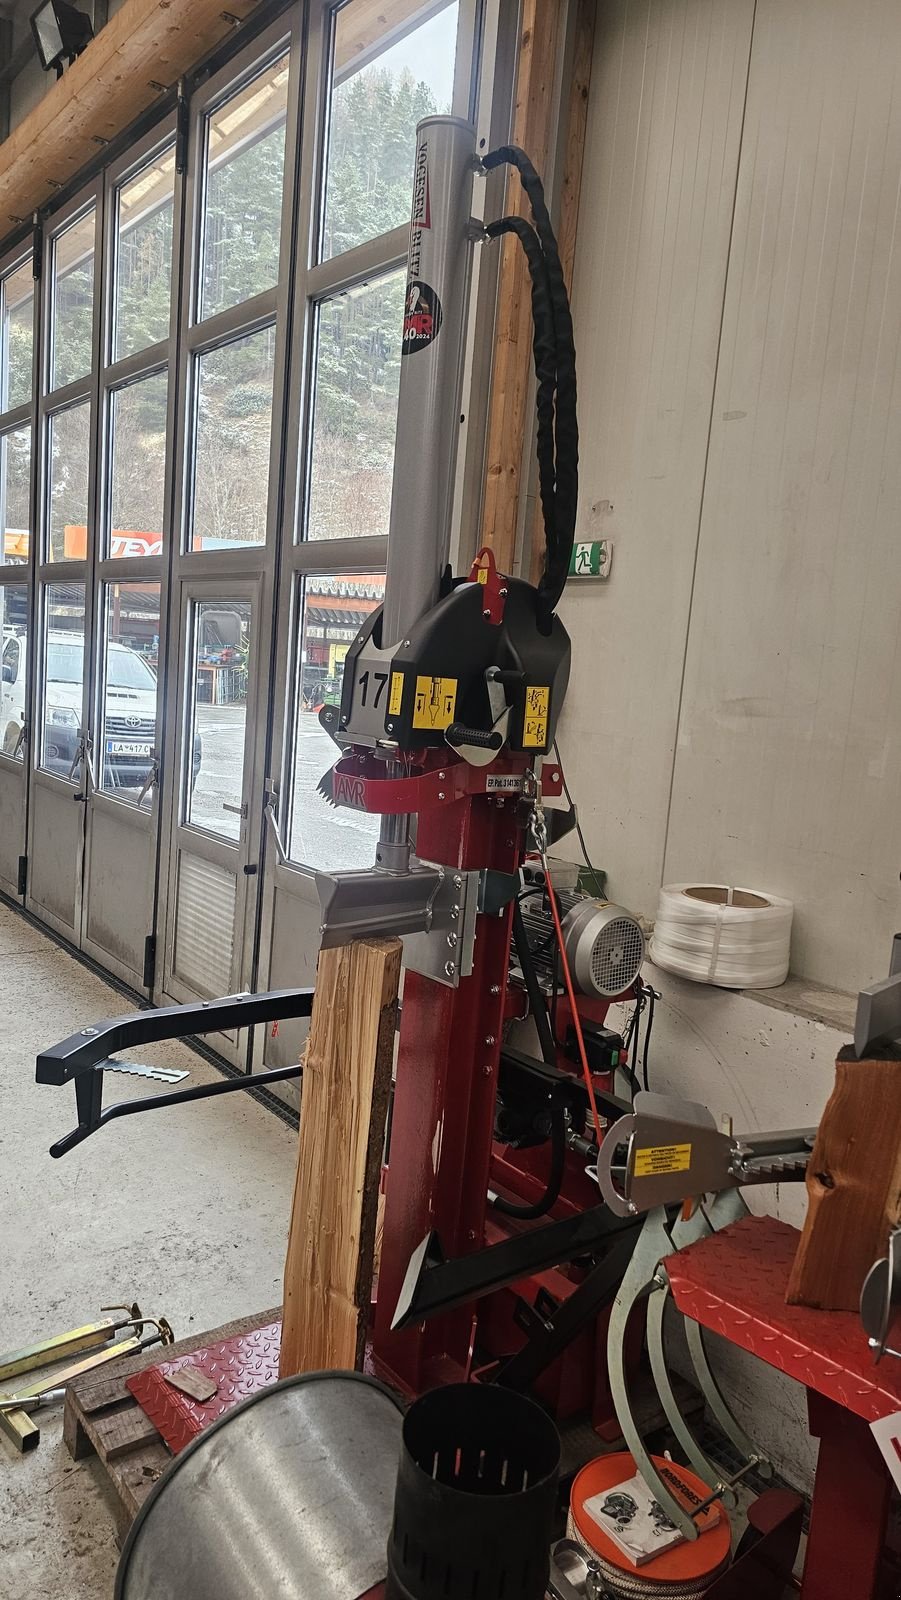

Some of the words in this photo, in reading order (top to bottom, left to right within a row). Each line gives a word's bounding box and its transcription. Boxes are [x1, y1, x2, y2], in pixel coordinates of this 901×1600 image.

[359, 670, 389, 709] 17
[129, 744, 143, 753] 417
[660, 1467, 704, 1508] NORDFORES
